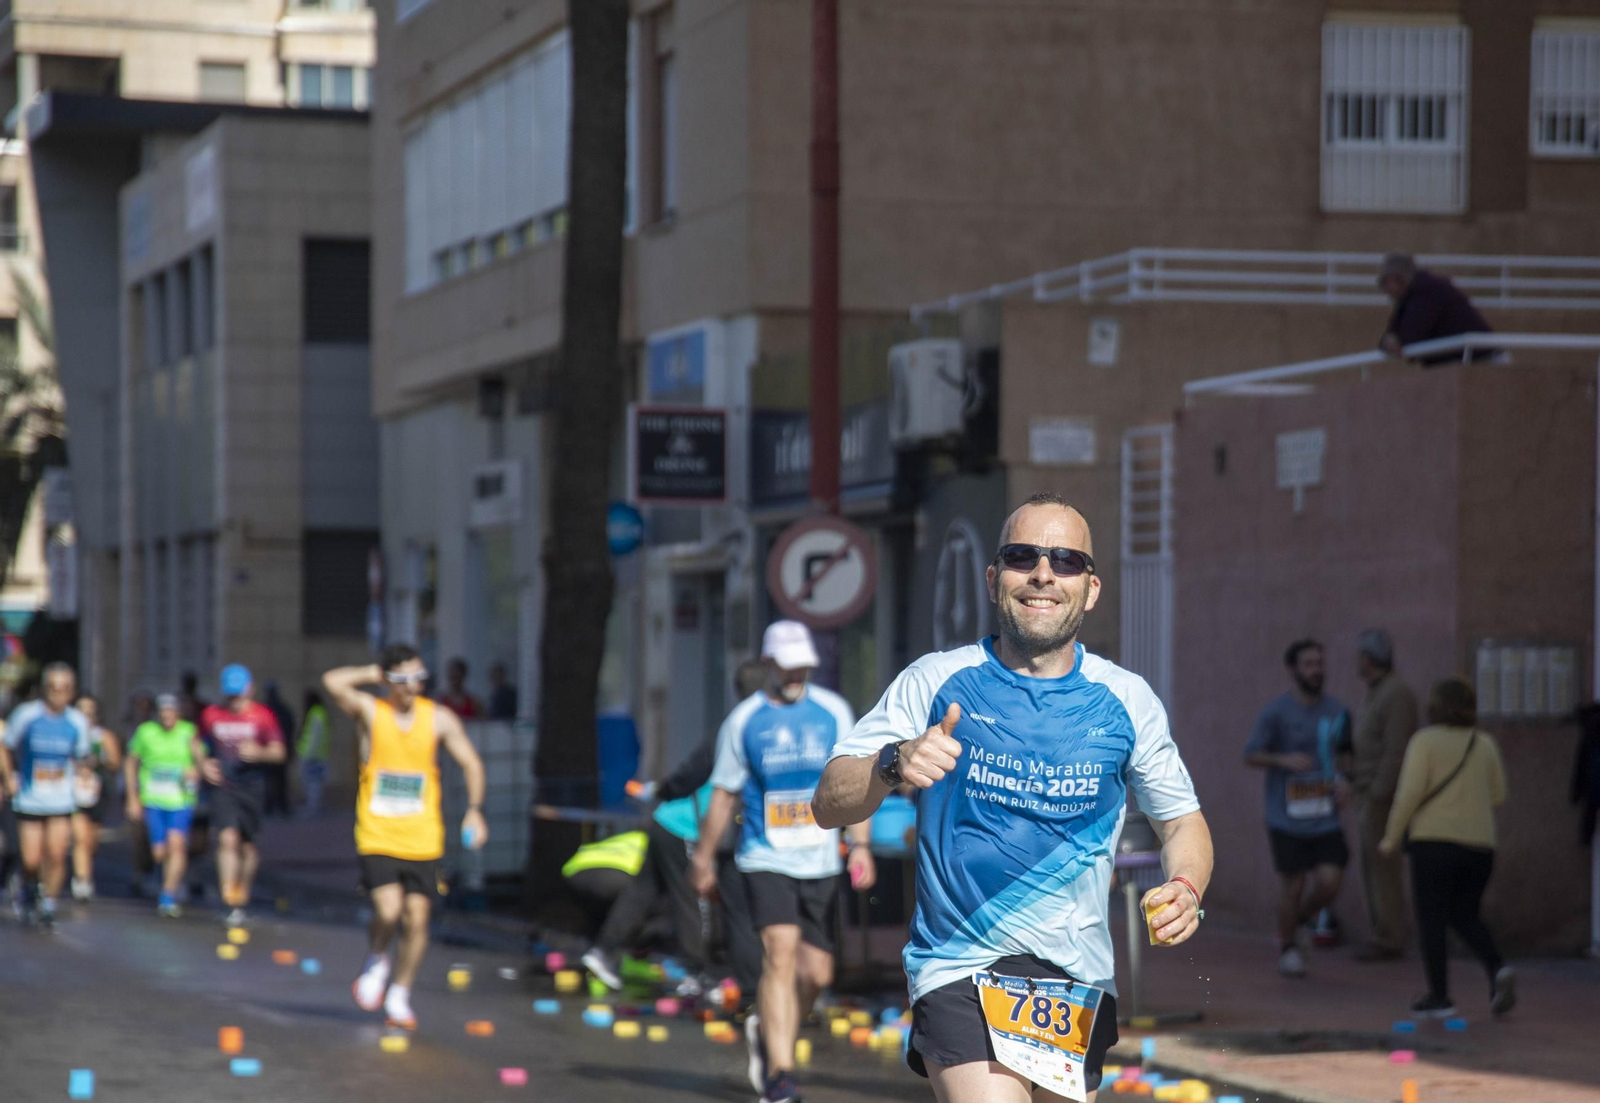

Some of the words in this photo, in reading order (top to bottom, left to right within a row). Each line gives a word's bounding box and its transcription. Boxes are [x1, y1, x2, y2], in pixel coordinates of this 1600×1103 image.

[969, 745, 1022, 771] Medio
[1029, 760, 1102, 777] Maratón
[966, 763, 1044, 795] Almería
[1046, 777, 1100, 797] 2025
[965, 787, 1006, 805] RAMÓN
[1011, 797, 1039, 810] RUIZ
[1042, 801, 1096, 813] ANDÚJAR
[1004, 980, 1023, 988] Medio
[1005, 990, 1072, 1037] 783
[1022, 1026, 1038, 1035] ALMA
[1045, 1032, 1055, 1041] EVA
